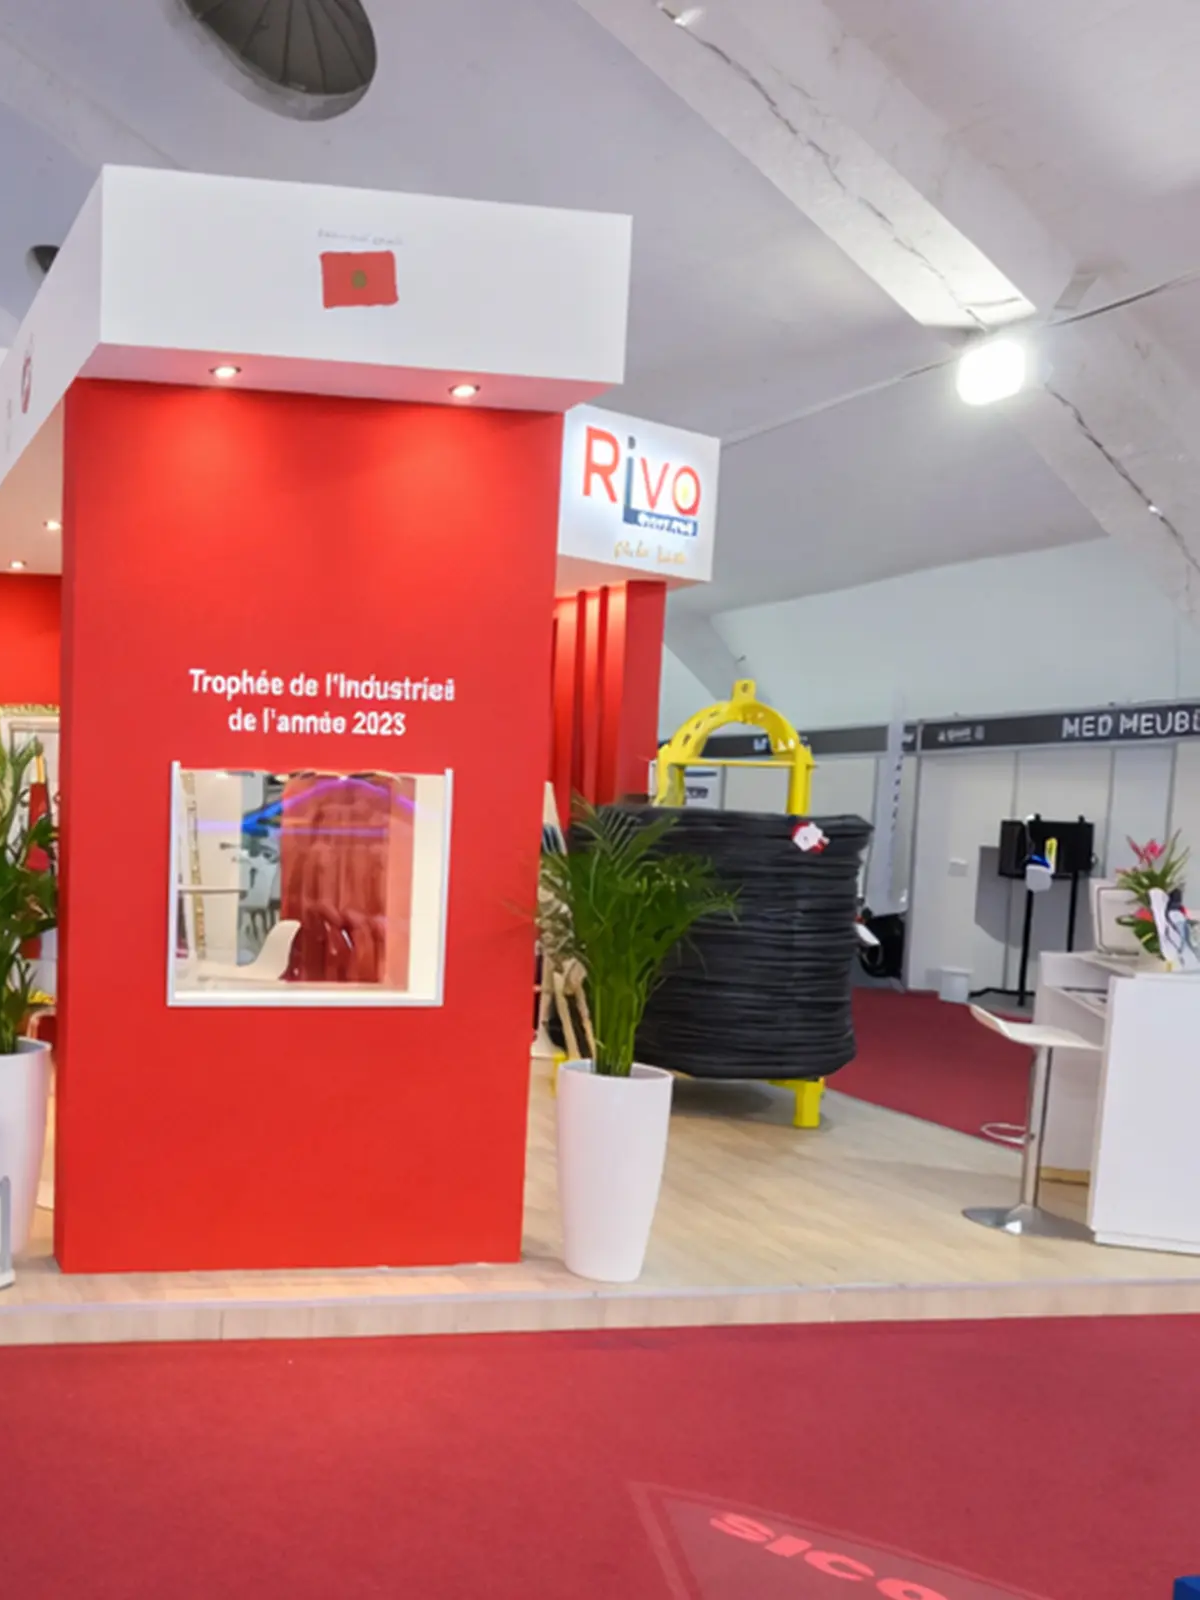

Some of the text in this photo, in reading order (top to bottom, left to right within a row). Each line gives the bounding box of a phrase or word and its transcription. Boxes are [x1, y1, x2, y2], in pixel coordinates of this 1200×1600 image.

[189, 669, 285, 702] Trophée
[290, 673, 319, 697] de
[228, 708, 258, 732] de
[1062, 714, 1114, 738] MED
